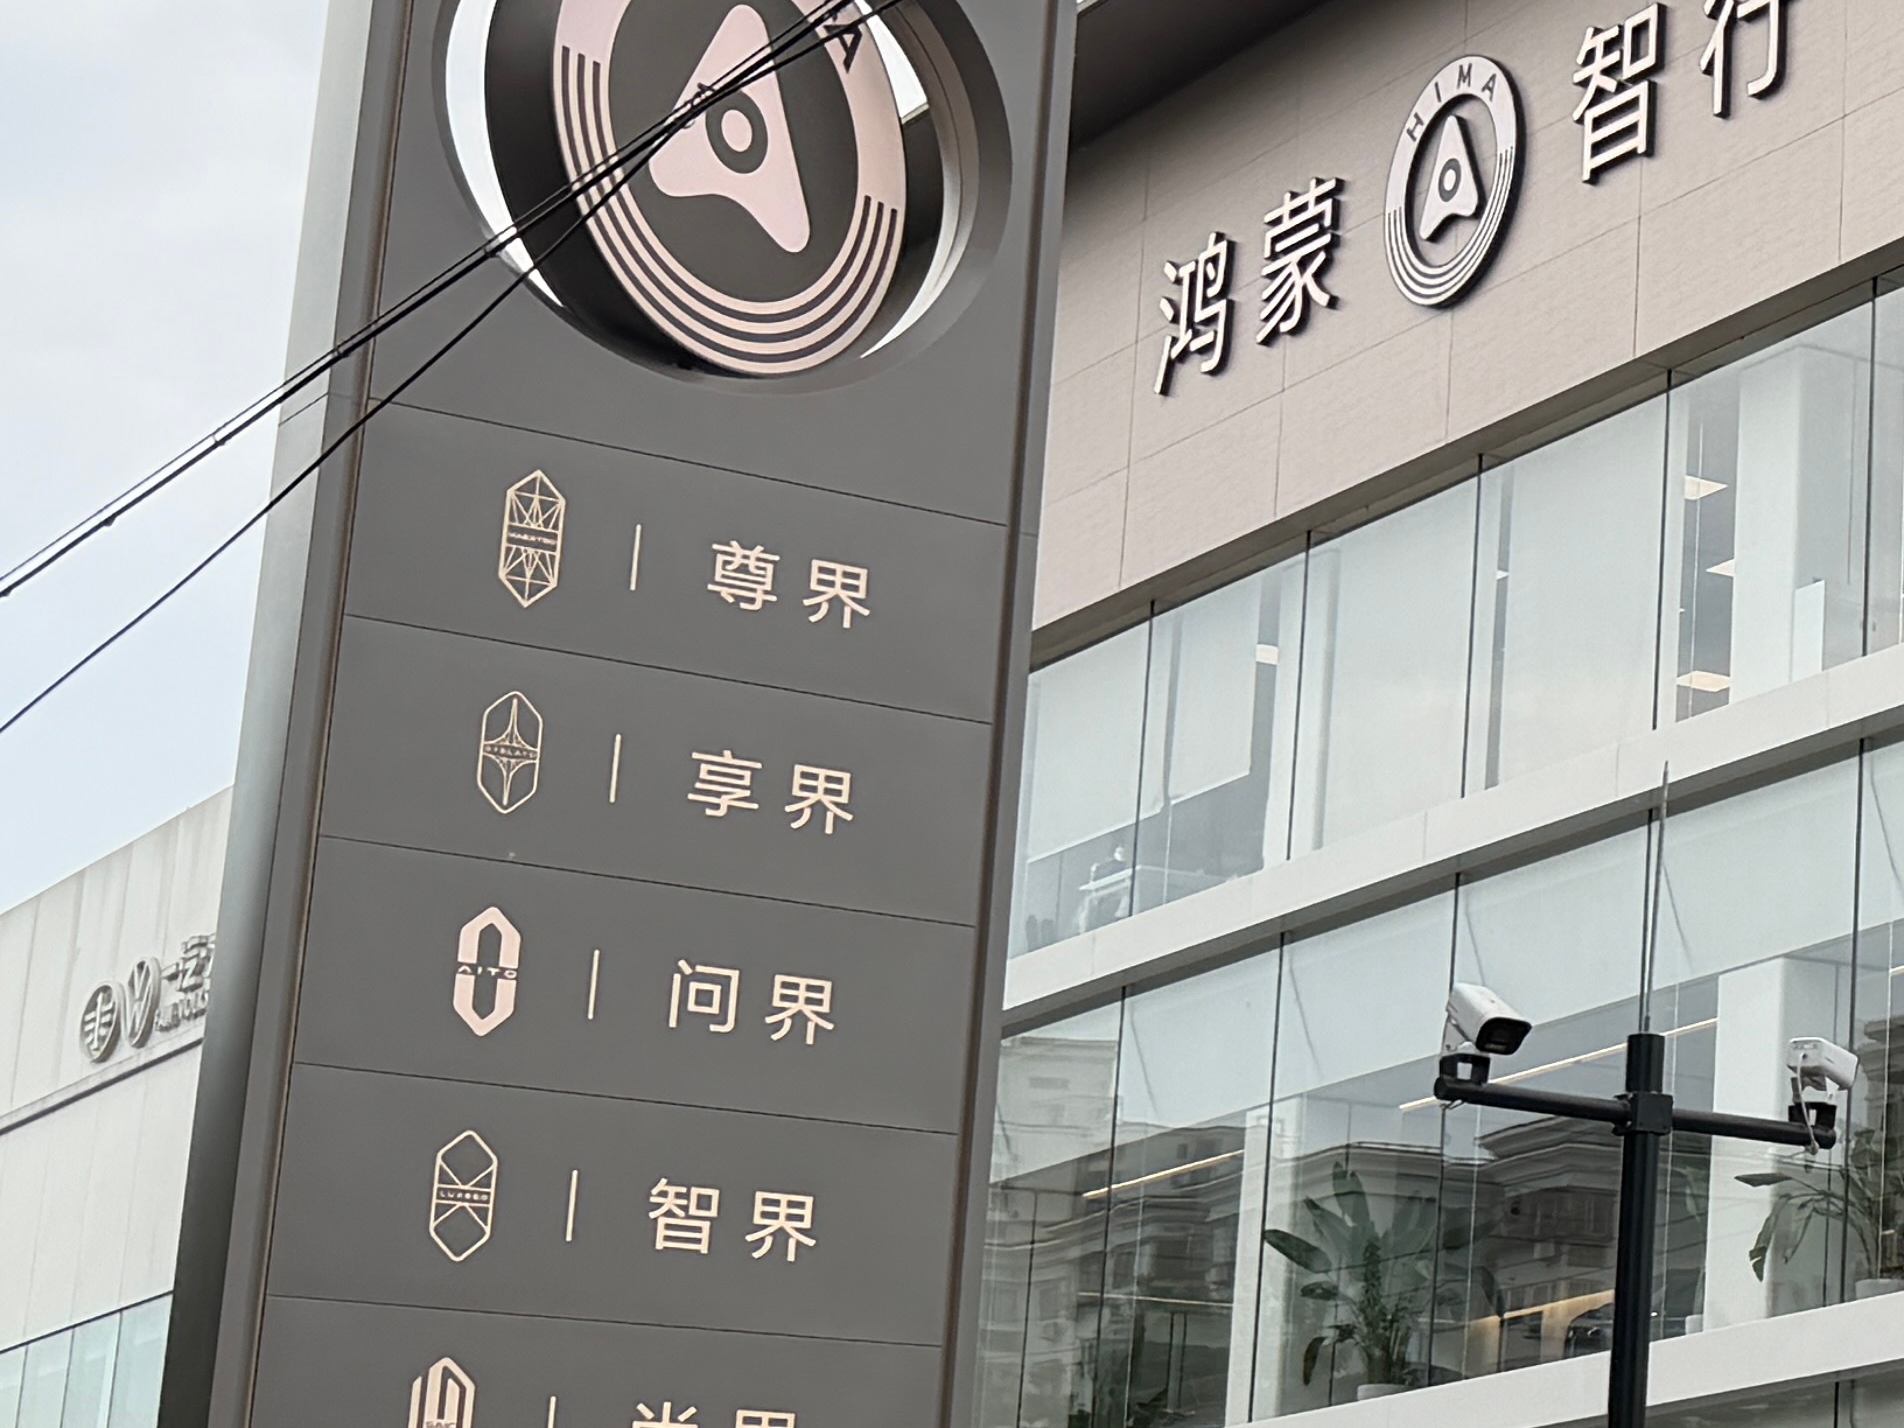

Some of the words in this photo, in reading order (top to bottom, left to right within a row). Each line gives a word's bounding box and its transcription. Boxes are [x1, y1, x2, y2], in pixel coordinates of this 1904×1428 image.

[1403, 63, 1498, 143] HIMA
[1153, 176, 1343, 395] 鸿蒙
[707, 540, 870, 629] 尊界
[687, 749, 854, 835] 享界
[668, 959, 836, 1045] 问界
[649, 1177, 816, 1262] 智界
